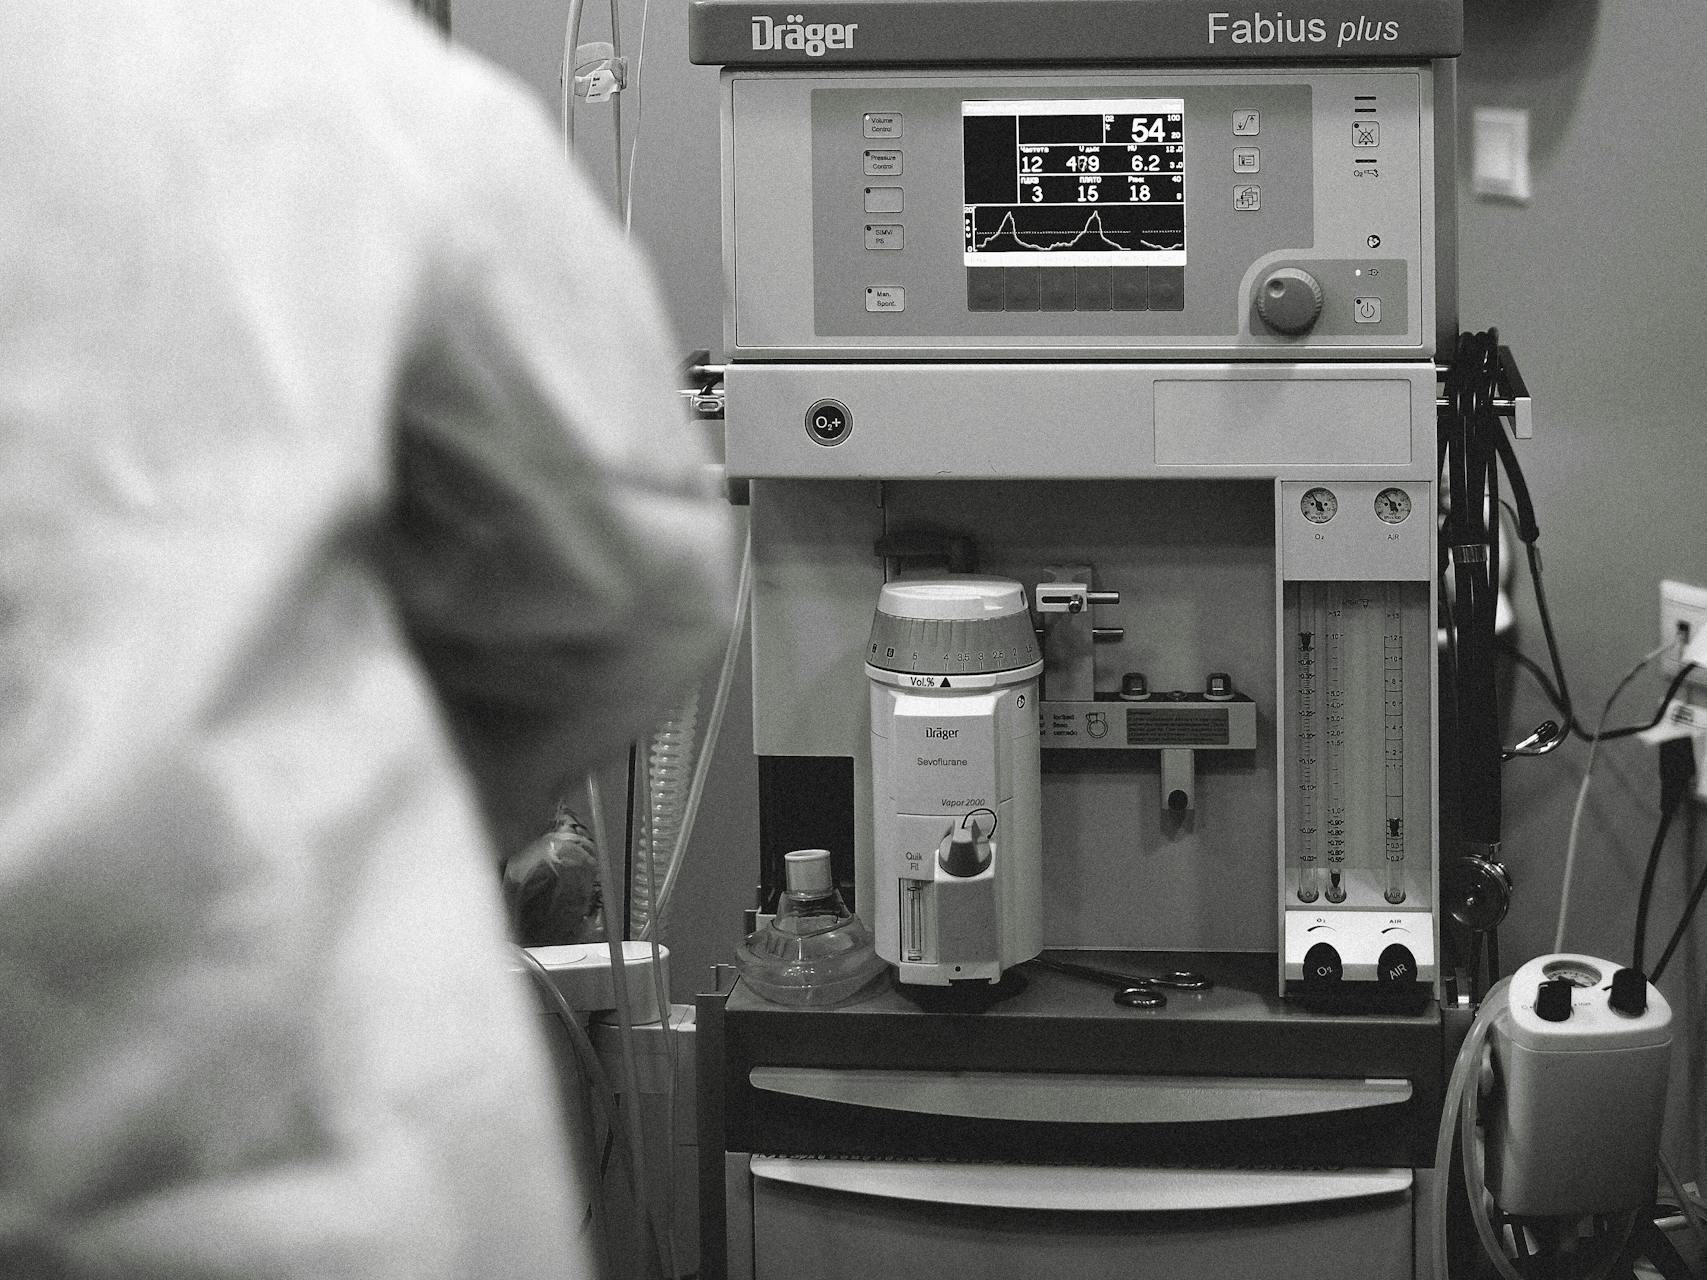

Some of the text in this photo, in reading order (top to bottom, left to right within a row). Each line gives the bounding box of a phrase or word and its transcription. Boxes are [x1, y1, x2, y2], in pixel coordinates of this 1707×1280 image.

[751, 14, 858, 57] Dräger
[1207, 13, 1400, 48] Fabius plus
[1131, 118, 1165, 142] 54
[1021, 156, 1043, 173] 12
[1131, 155, 1160, 171] 6.2
[1172, 175, 1182, 183] 40
[1031, 186, 1043, 202] 3
[1077, 185, 1099, 202] 15
[1129, 185, 1151, 201] 18
[912, 652, 918, 660] 5
[978, 652, 984, 660] 3
[910, 677, 935, 687] Vol.%
[917, 757, 968, 767] Sevoflurane
[941, 798, 986, 808] Vapor 2000
[905, 852, 923, 862] Quik
[1388, 963, 1408, 981] AIR
